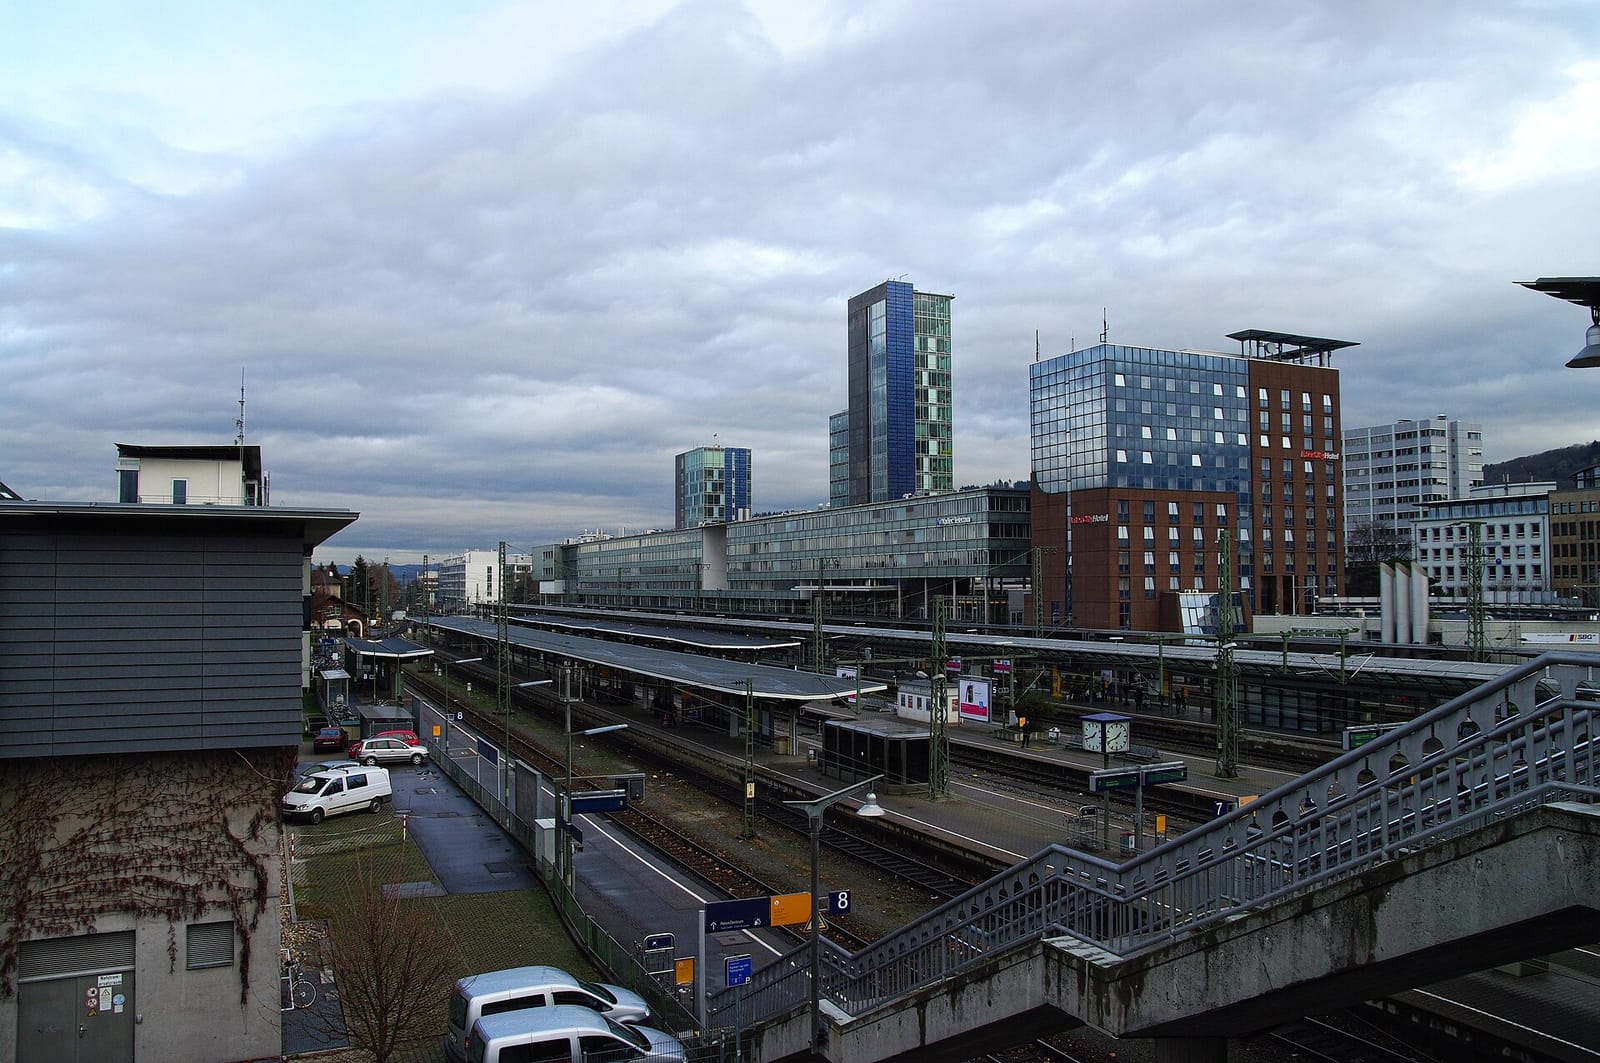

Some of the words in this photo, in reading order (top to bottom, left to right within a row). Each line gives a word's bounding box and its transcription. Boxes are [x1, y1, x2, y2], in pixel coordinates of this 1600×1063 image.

[456, 711, 463, 720] 8
[1216, 802, 1223, 816] 7
[838, 892, 848, 909] 8
